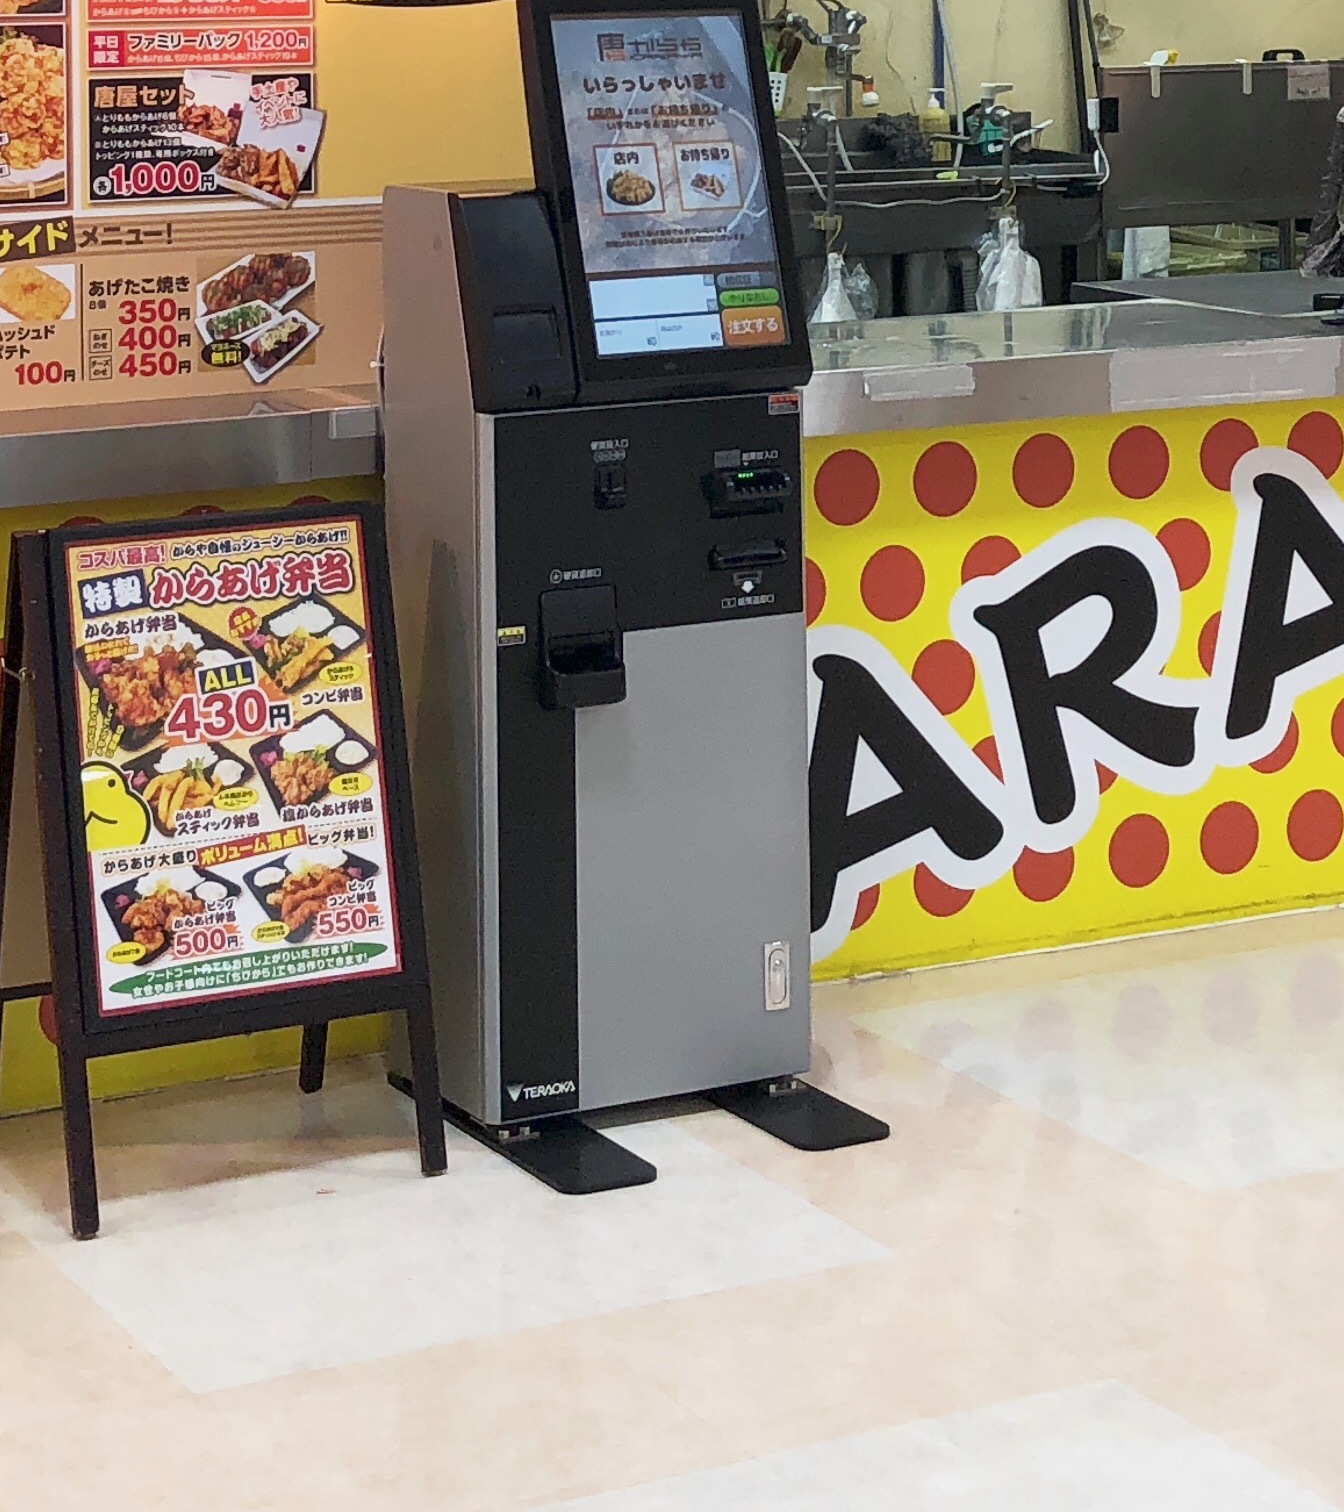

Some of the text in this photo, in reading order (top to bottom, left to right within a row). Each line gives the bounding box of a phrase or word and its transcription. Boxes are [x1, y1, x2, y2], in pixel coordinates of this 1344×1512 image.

[129, 31, 308, 50] ファミリーパック 1,200円
[583, 73, 726, 93] いらっしゃいませ
[94, 85, 195, 108] 唐屋セット
[614, 152, 639, 165] 店内
[111, 160, 217, 197] 1,000円
[88, 276, 190, 298] あげたこ焼き
[119, 299, 191, 324] 350円
[119, 325, 191, 351] 400円
[728, 318, 778, 335] 注文する
[15, 361, 76, 387] 100円
[119, 352, 192, 378] 450円
[79, 545, 166, 569] コスパ最高!
[83, 553, 352, 612] 特製 からあげ弁当
[85, 615, 177, 638] からあげ弁当
[203, 665, 252, 691] ALL
[301, 687, 363, 705] コンビ弁当
[168, 690, 291, 738] 430円
[177, 812, 259, 835] スティック弁当
[104, 851, 196, 874] からあげ大盛り
[328, 891, 377, 907] コンビ弁当
[174, 910, 235, 929] からあげ弁当
[318, 909, 380, 935] 550円
[176, 928, 239, 956] 500円
[523, 1081, 576, 1099] TERAOKA
